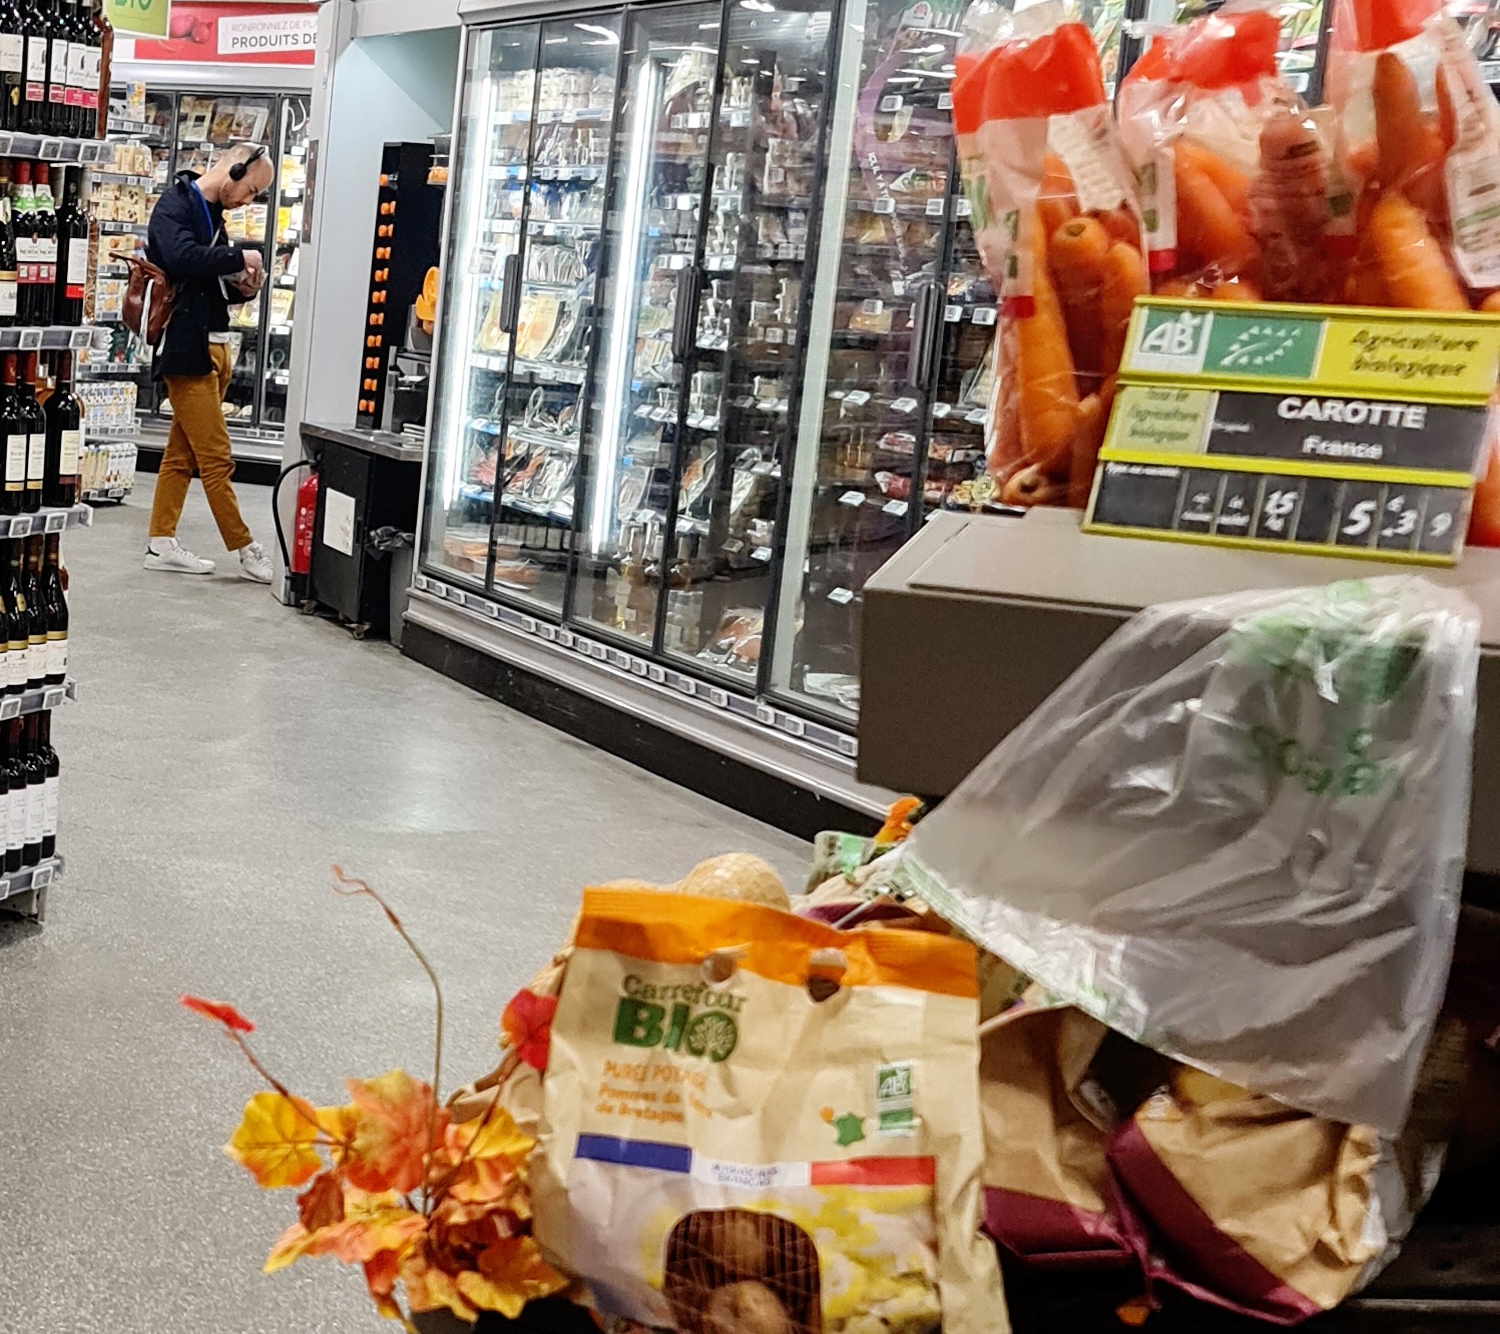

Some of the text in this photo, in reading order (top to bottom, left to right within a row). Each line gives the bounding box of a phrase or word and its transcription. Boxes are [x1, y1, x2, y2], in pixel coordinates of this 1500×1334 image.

[231, 22, 288, 32] RONRONNEZ
[289, 21, 301, 30] DE
[231, 33, 318, 48] PRODUITS DE
[1140, 321, 1195, 355] AB
[1277, 398, 1427, 430] CAROTTE
[1303, 436, 1383, 460] France
[622, 975, 748, 1013] Carrefour
[613, 997, 738, 1063] BIO
